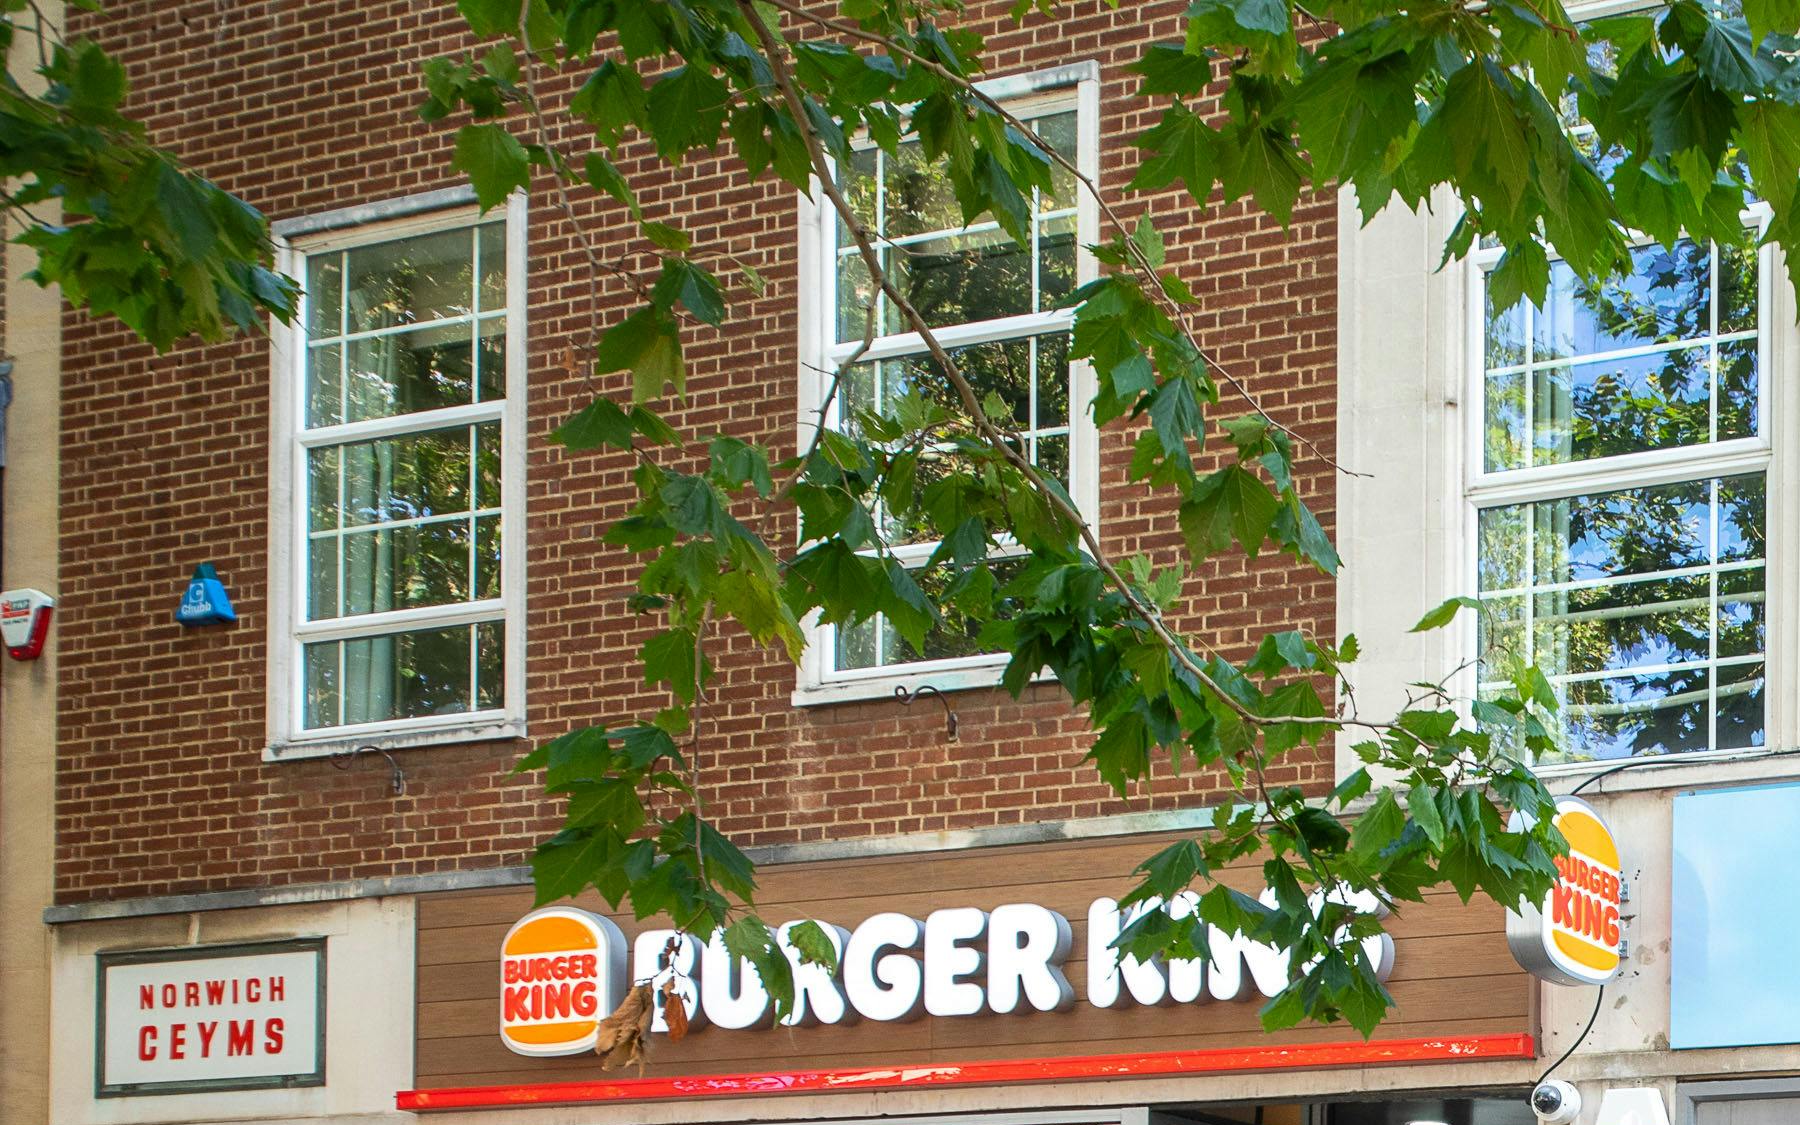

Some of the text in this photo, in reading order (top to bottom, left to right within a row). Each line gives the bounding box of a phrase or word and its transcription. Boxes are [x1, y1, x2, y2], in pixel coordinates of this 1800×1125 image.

[1553, 886, 1620, 946] KING
[504, 954, 599, 984] BURGER
[633, 902, 1062, 1033] BURGER
[139, 976, 284, 1010] NORWICH
[504, 980, 598, 1022] KING
[138, 1017, 284, 1061] CEYMS
